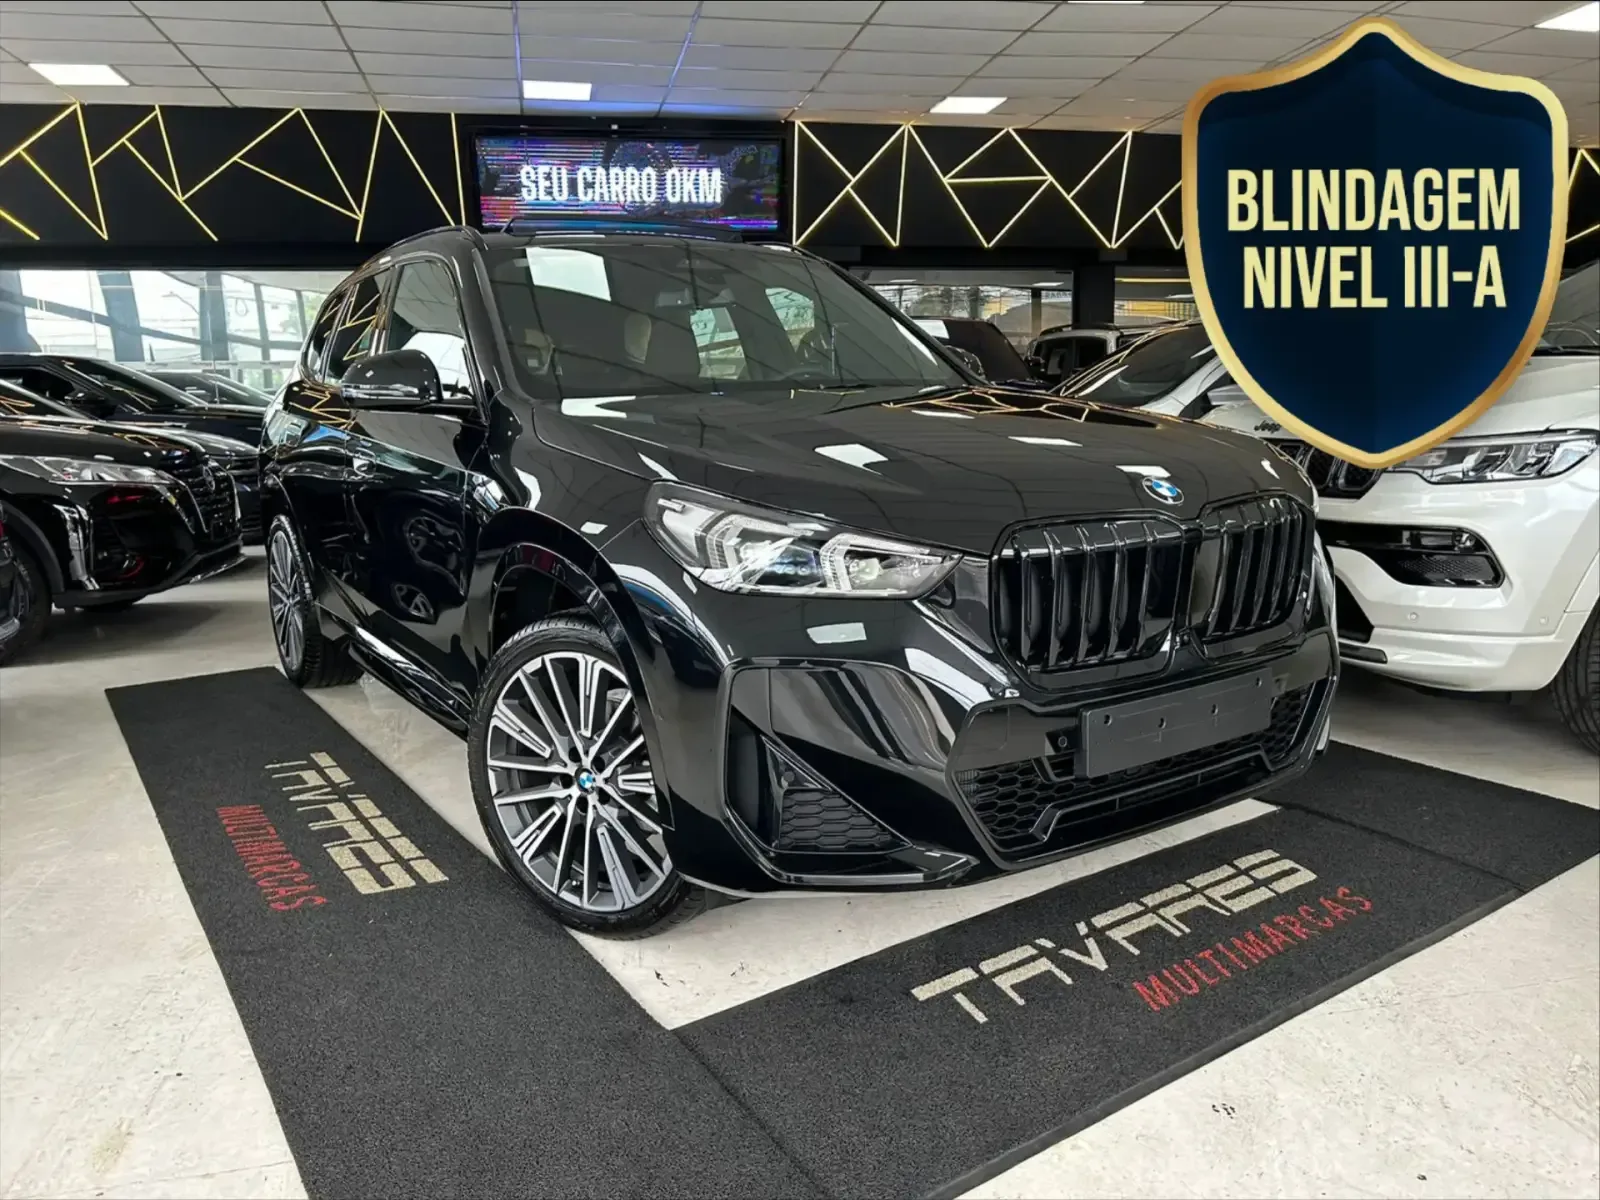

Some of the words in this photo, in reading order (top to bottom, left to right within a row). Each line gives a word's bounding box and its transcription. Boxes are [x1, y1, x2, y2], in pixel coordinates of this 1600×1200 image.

[519, 164, 569, 202] SEU
[576, 165, 657, 203] CARRO
[216, 804, 327, 911] MULTIMARCAS
[264, 751, 449, 895] TAVARES
[911, 849, 1318, 1024] TAVARES
[1132, 885, 1374, 1012] MULTIMARCAS
